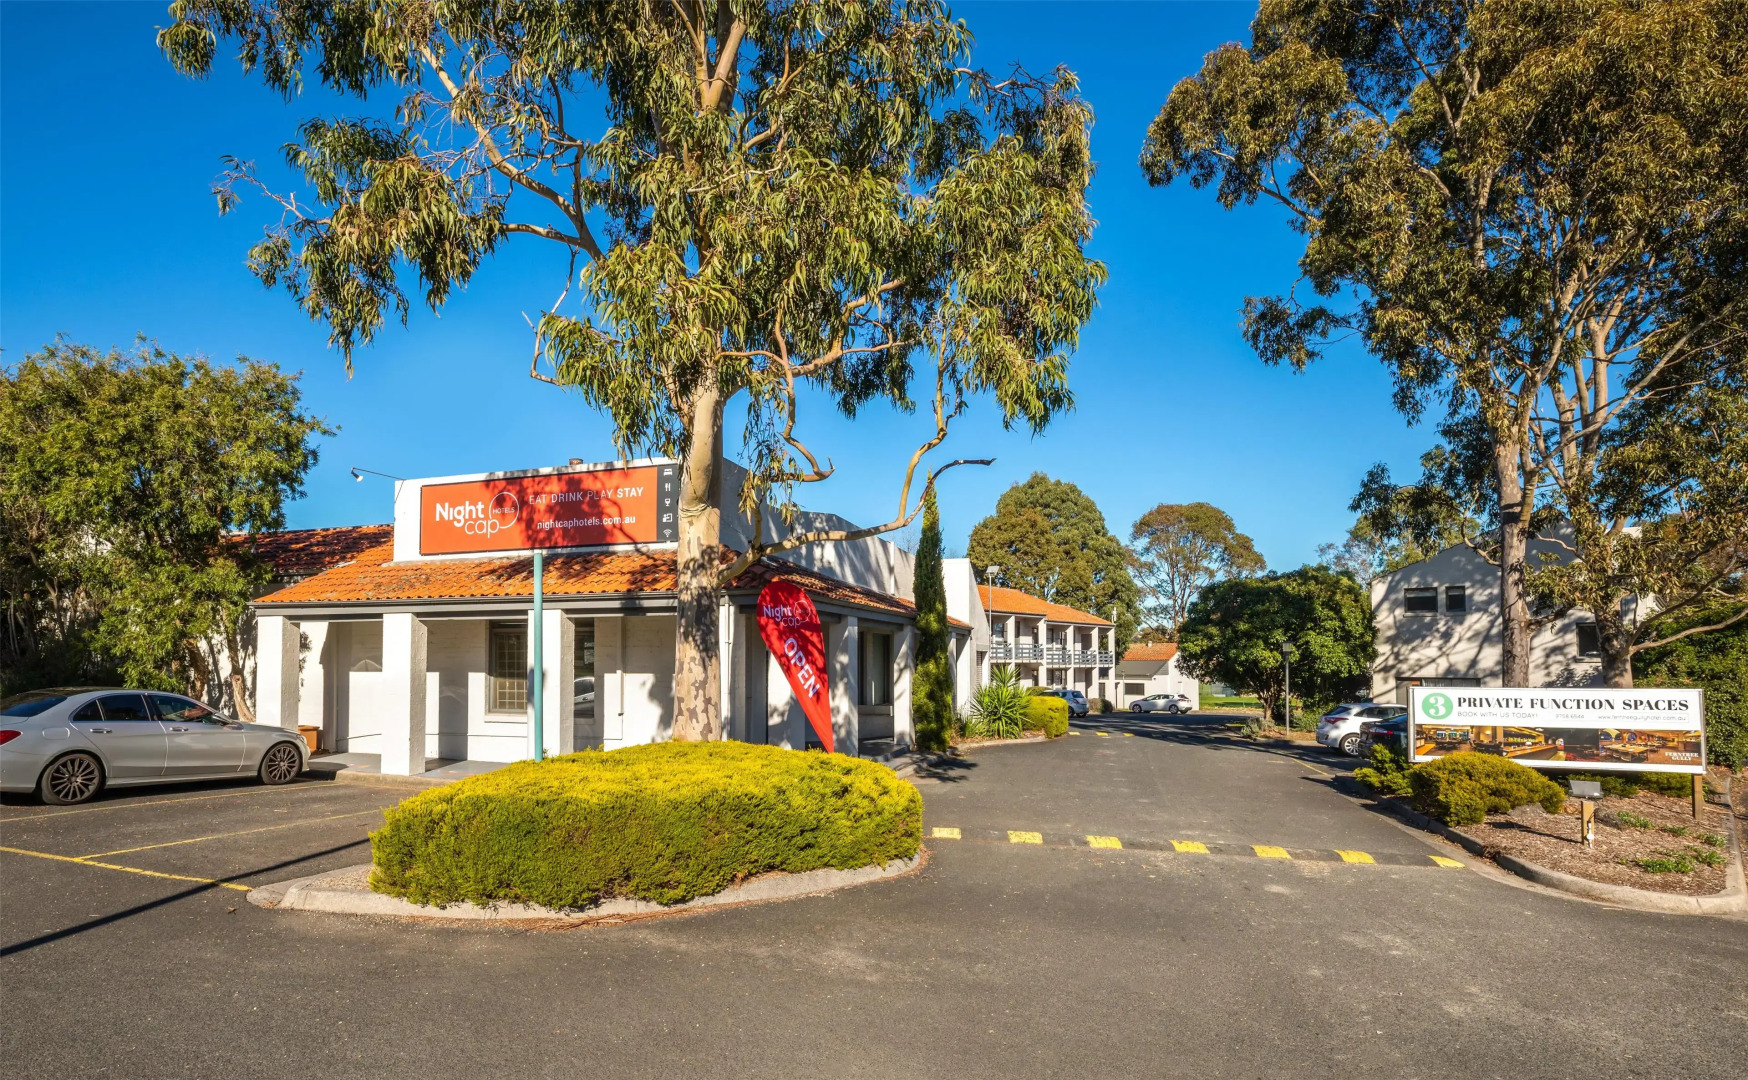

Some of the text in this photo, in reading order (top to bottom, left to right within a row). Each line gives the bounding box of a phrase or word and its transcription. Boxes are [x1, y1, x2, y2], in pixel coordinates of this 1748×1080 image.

[528, 487, 645, 505] EAT DRINK PLAY STAY
[435, 501, 485, 528] Night
[492, 506, 516, 514] HOTELS
[464, 519, 500, 539] cap
[536, 515, 636, 531] nightcaphotels.com.au
[763, 604, 792, 622] Night
[781, 616, 801, 629] cap
[784, 638, 821, 699] OPEN
[1428, 695, 1689, 717] 3 PRIVATE FUNCTION SPACES
[1457, 710, 1478, 718] BOOK
